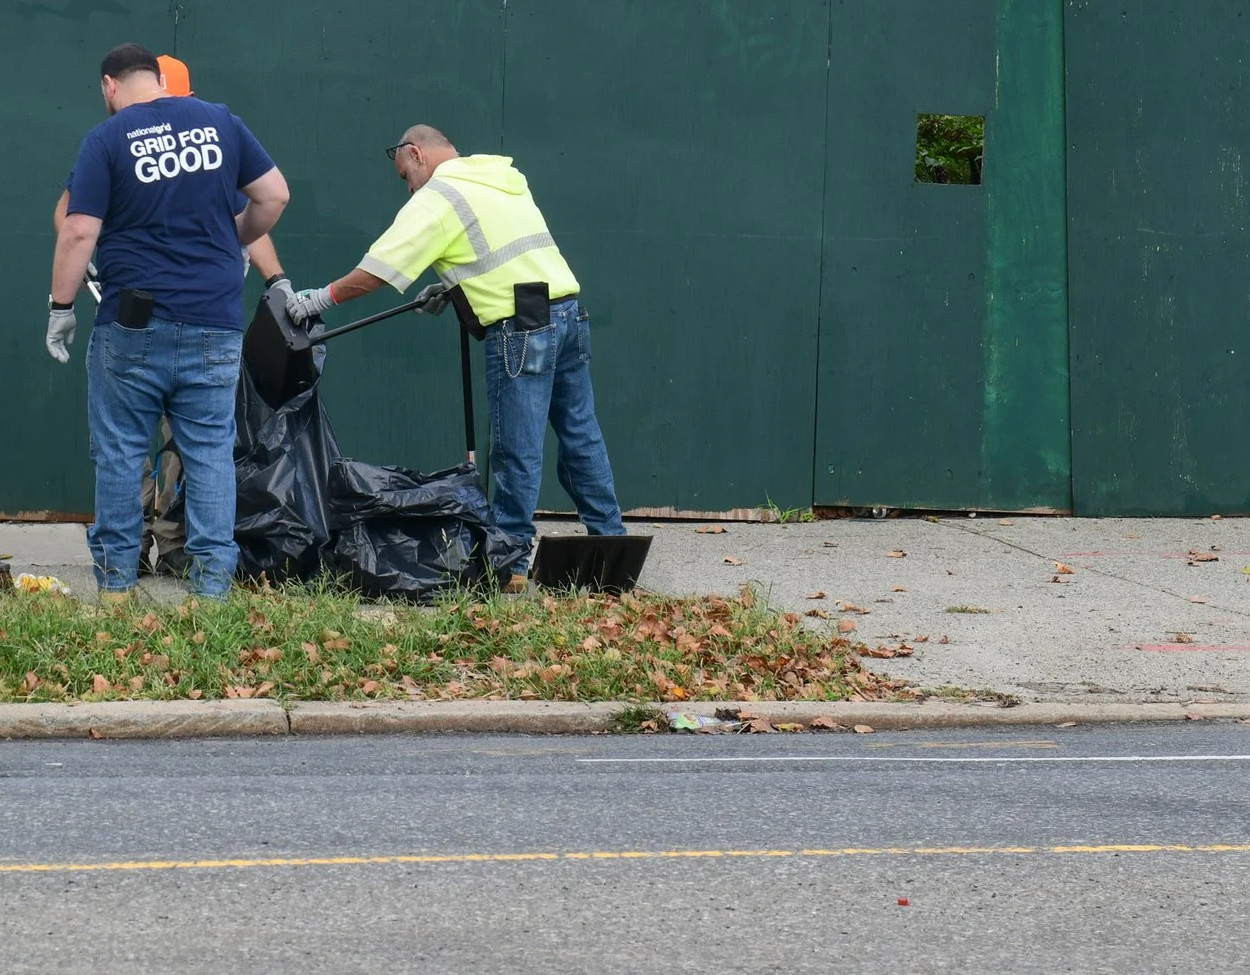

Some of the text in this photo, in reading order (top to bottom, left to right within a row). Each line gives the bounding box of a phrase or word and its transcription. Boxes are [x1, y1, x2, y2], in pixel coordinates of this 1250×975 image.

[130, 127, 220, 157] GRID FOR
[134, 144, 223, 183] GOOD
